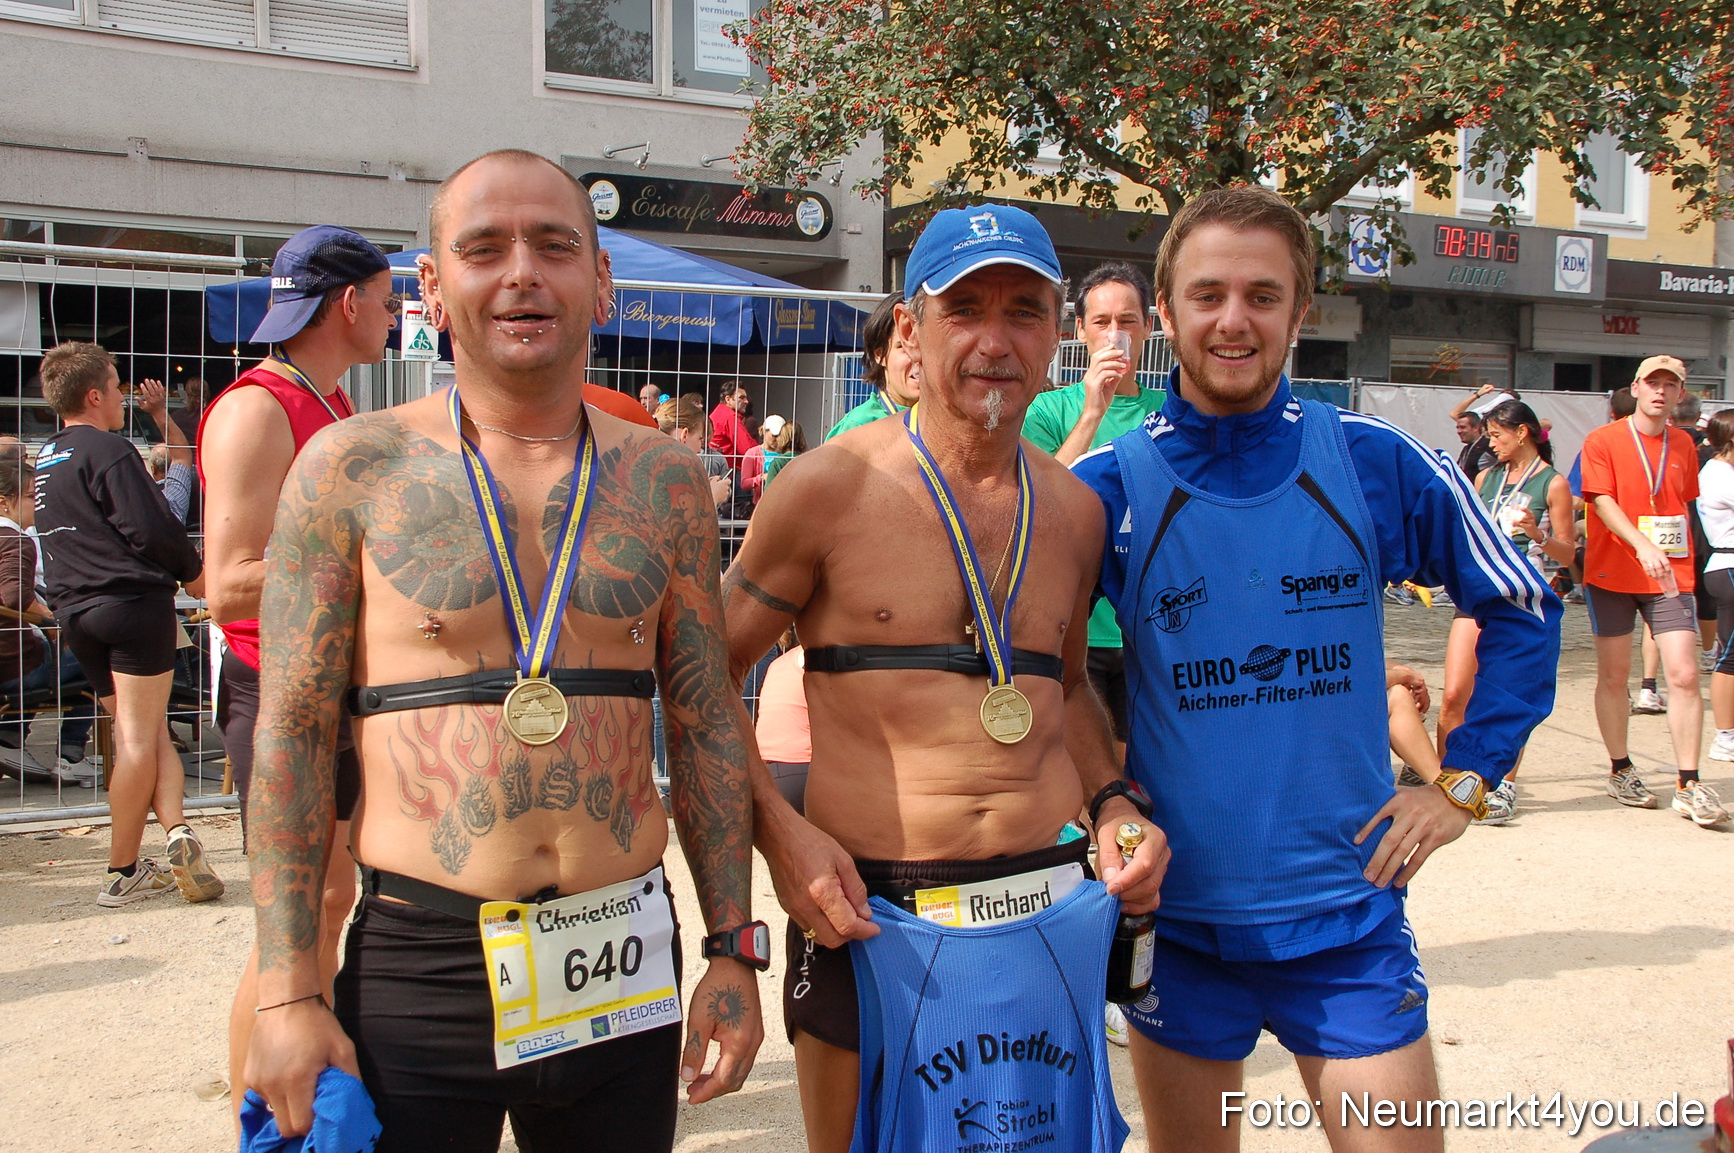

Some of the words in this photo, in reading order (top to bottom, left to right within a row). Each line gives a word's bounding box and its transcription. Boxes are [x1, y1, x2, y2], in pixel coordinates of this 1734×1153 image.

[699, 6, 745, 18] vermieten
[716, 194, 794, 228] Mimmo
[1562, 255, 1586, 273] RDM
[623, 300, 716, 330] Biergenuss
[484, 496, 495, 516] dabei
[497, 540, 504, 550] 10
[1658, 532, 1682, 545] 226
[499, 549, 509, 568] Jahre
[504, 568, 519, 608] Neumarkter
[1281, 565, 1360, 605] Spangler
[537, 632, 547, 650] Jahre
[542, 593, 557, 632] Neumarkter
[552, 565, 565, 594] Stadtlauf
[1160, 588, 1203, 613] SPORT
[515, 608, 528, 638] Stadtlauf
[1172, 657, 1236, 690] EURO
[1295, 642, 1351, 676] PLUS
[1178, 676, 1352, 713] Aichner-Filter-Werk
[970, 881, 1052, 923] Richard
[500, 962, 512, 987] A
[564, 935, 644, 993] 640
[610, 997, 677, 1026] PFLEIDERER
[613, 1011, 679, 1034] AKTIENGESELLSCHAFT
[1132, 1011, 1164, 1028] FINANZ
[516, 1031, 565, 1054] BOCK
[914, 1039, 966, 1092] TSV
[995, 1098, 1029, 1110] Tobias
[996, 1102, 1055, 1133] Strobl
[956, 1132, 1055, 1153] THERAPIEZENTRUM
